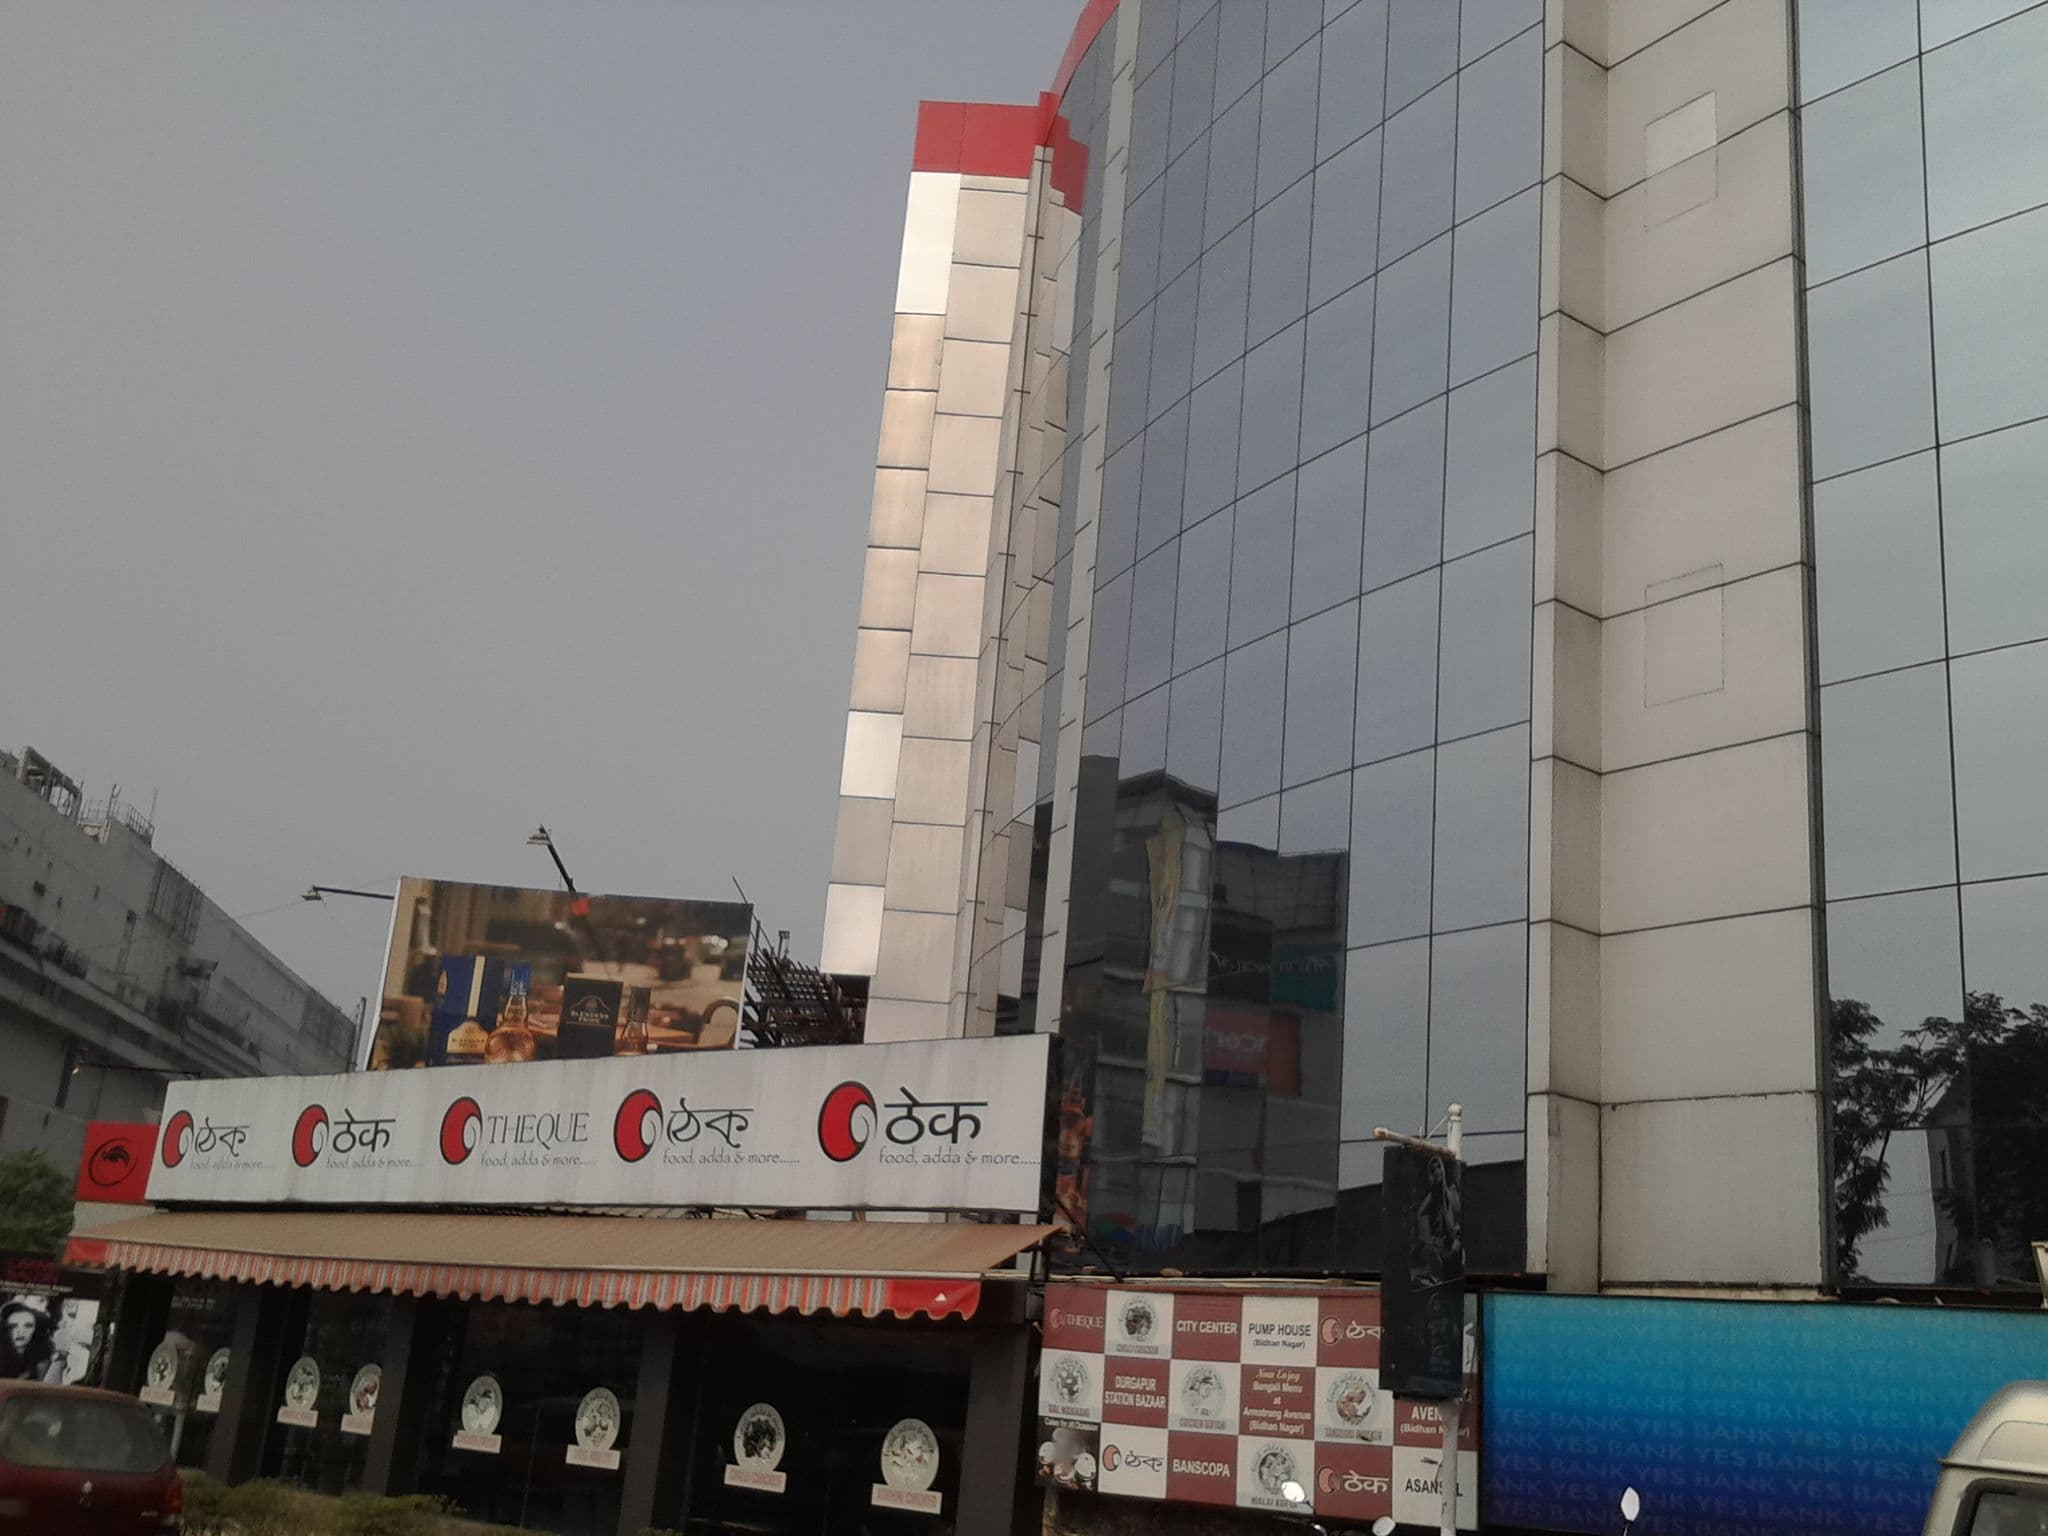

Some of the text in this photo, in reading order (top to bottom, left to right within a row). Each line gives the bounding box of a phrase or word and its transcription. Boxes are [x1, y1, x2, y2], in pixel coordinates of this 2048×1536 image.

[667, 1097, 754, 1148] ঠেক
[884, 1086, 988, 1145] ठेक
[333, 1107, 396, 1153] ठेक
[488, 1112, 590, 1150] THEQUE
[922, 1146, 960, 1164] adda
[965, 1151, 977, 1165] &
[1176, 1320, 1238, 1335] CITY CENTER
[1248, 1322, 1311, 1337] PUMP HOUSE
[1115, 1376, 1156, 1391] DURGAPUR
[1104, 1391, 1166, 1408] STATION BAZAAR
[1411, 1406, 1443, 1420] AVEN
[1400, 1423, 1436, 1434] (Bidhan
[1172, 1459, 1230, 1477] BANSCOPA
[1342, 1469, 1389, 1493] ठेक
[1405, 1478, 1463, 1497] ASANL
